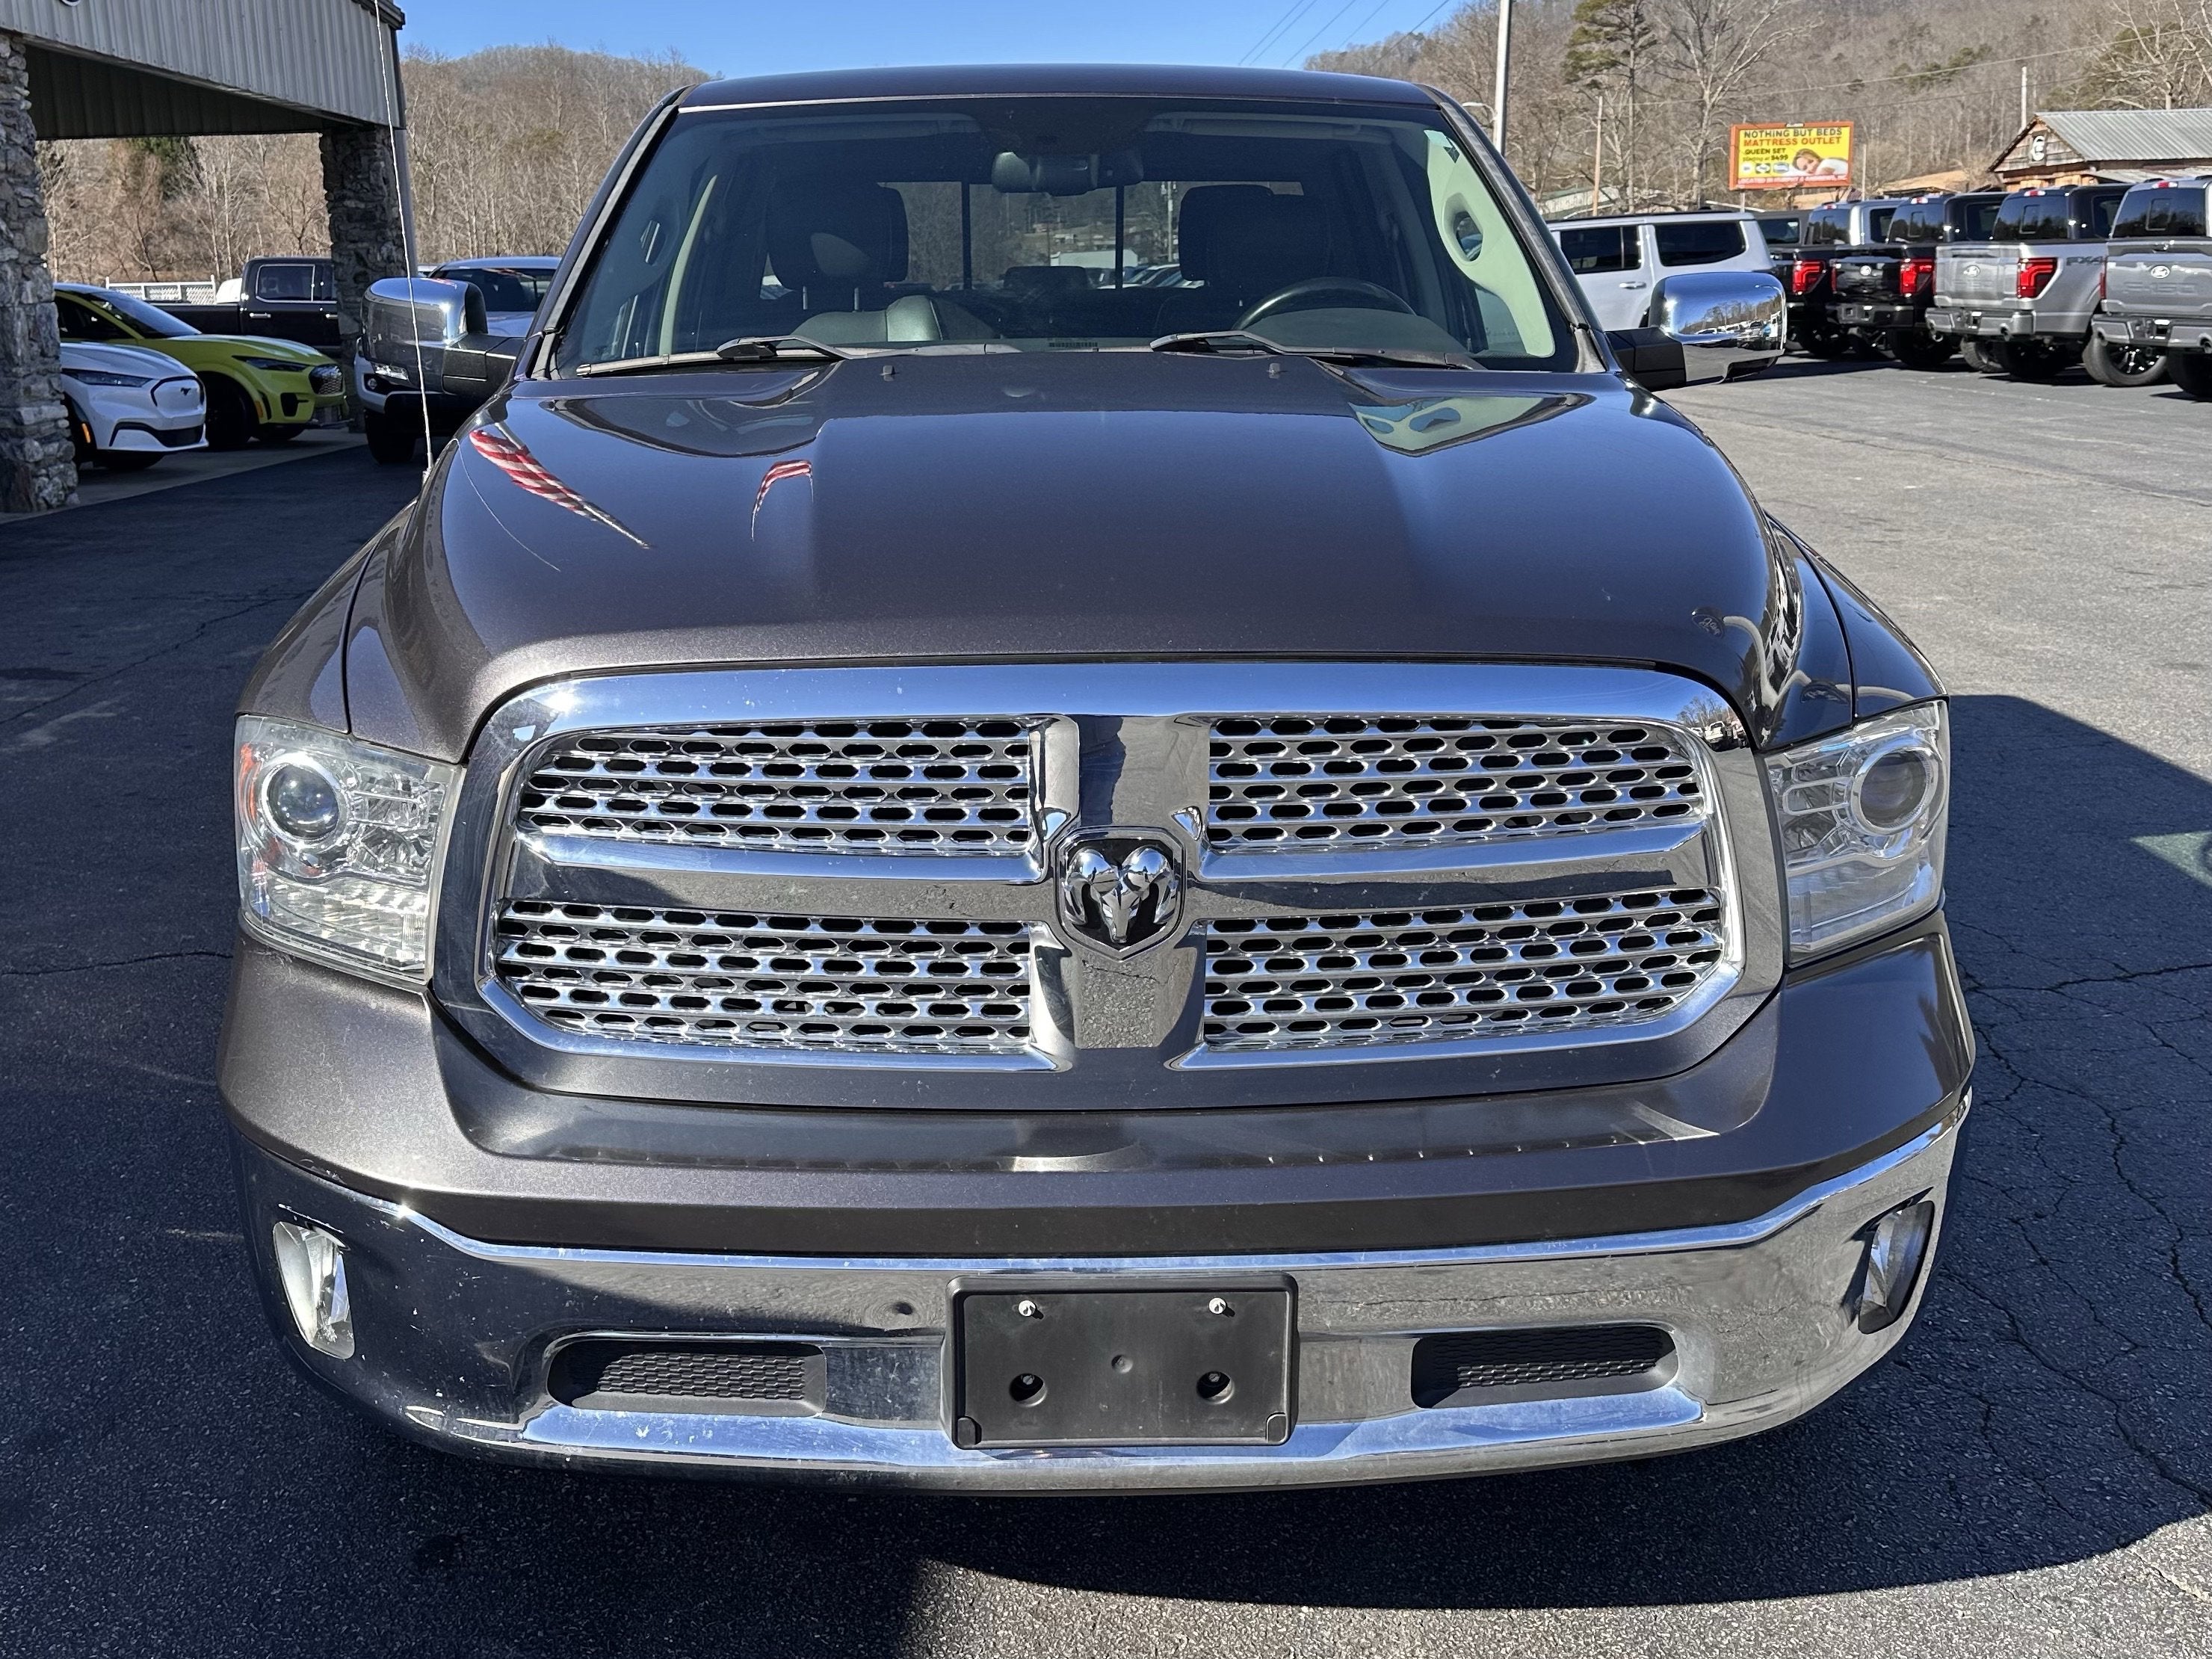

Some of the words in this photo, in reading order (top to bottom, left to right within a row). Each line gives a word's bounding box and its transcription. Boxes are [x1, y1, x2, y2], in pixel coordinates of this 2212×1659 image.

[1743, 129, 1790, 138] NOTHING
[1794, 129, 1812, 137] BUT
[1816, 128, 1842, 136] BEDS
[1743, 138, 1797, 146] MATTRESS
[1801, 137, 1841, 145] OUTLET
